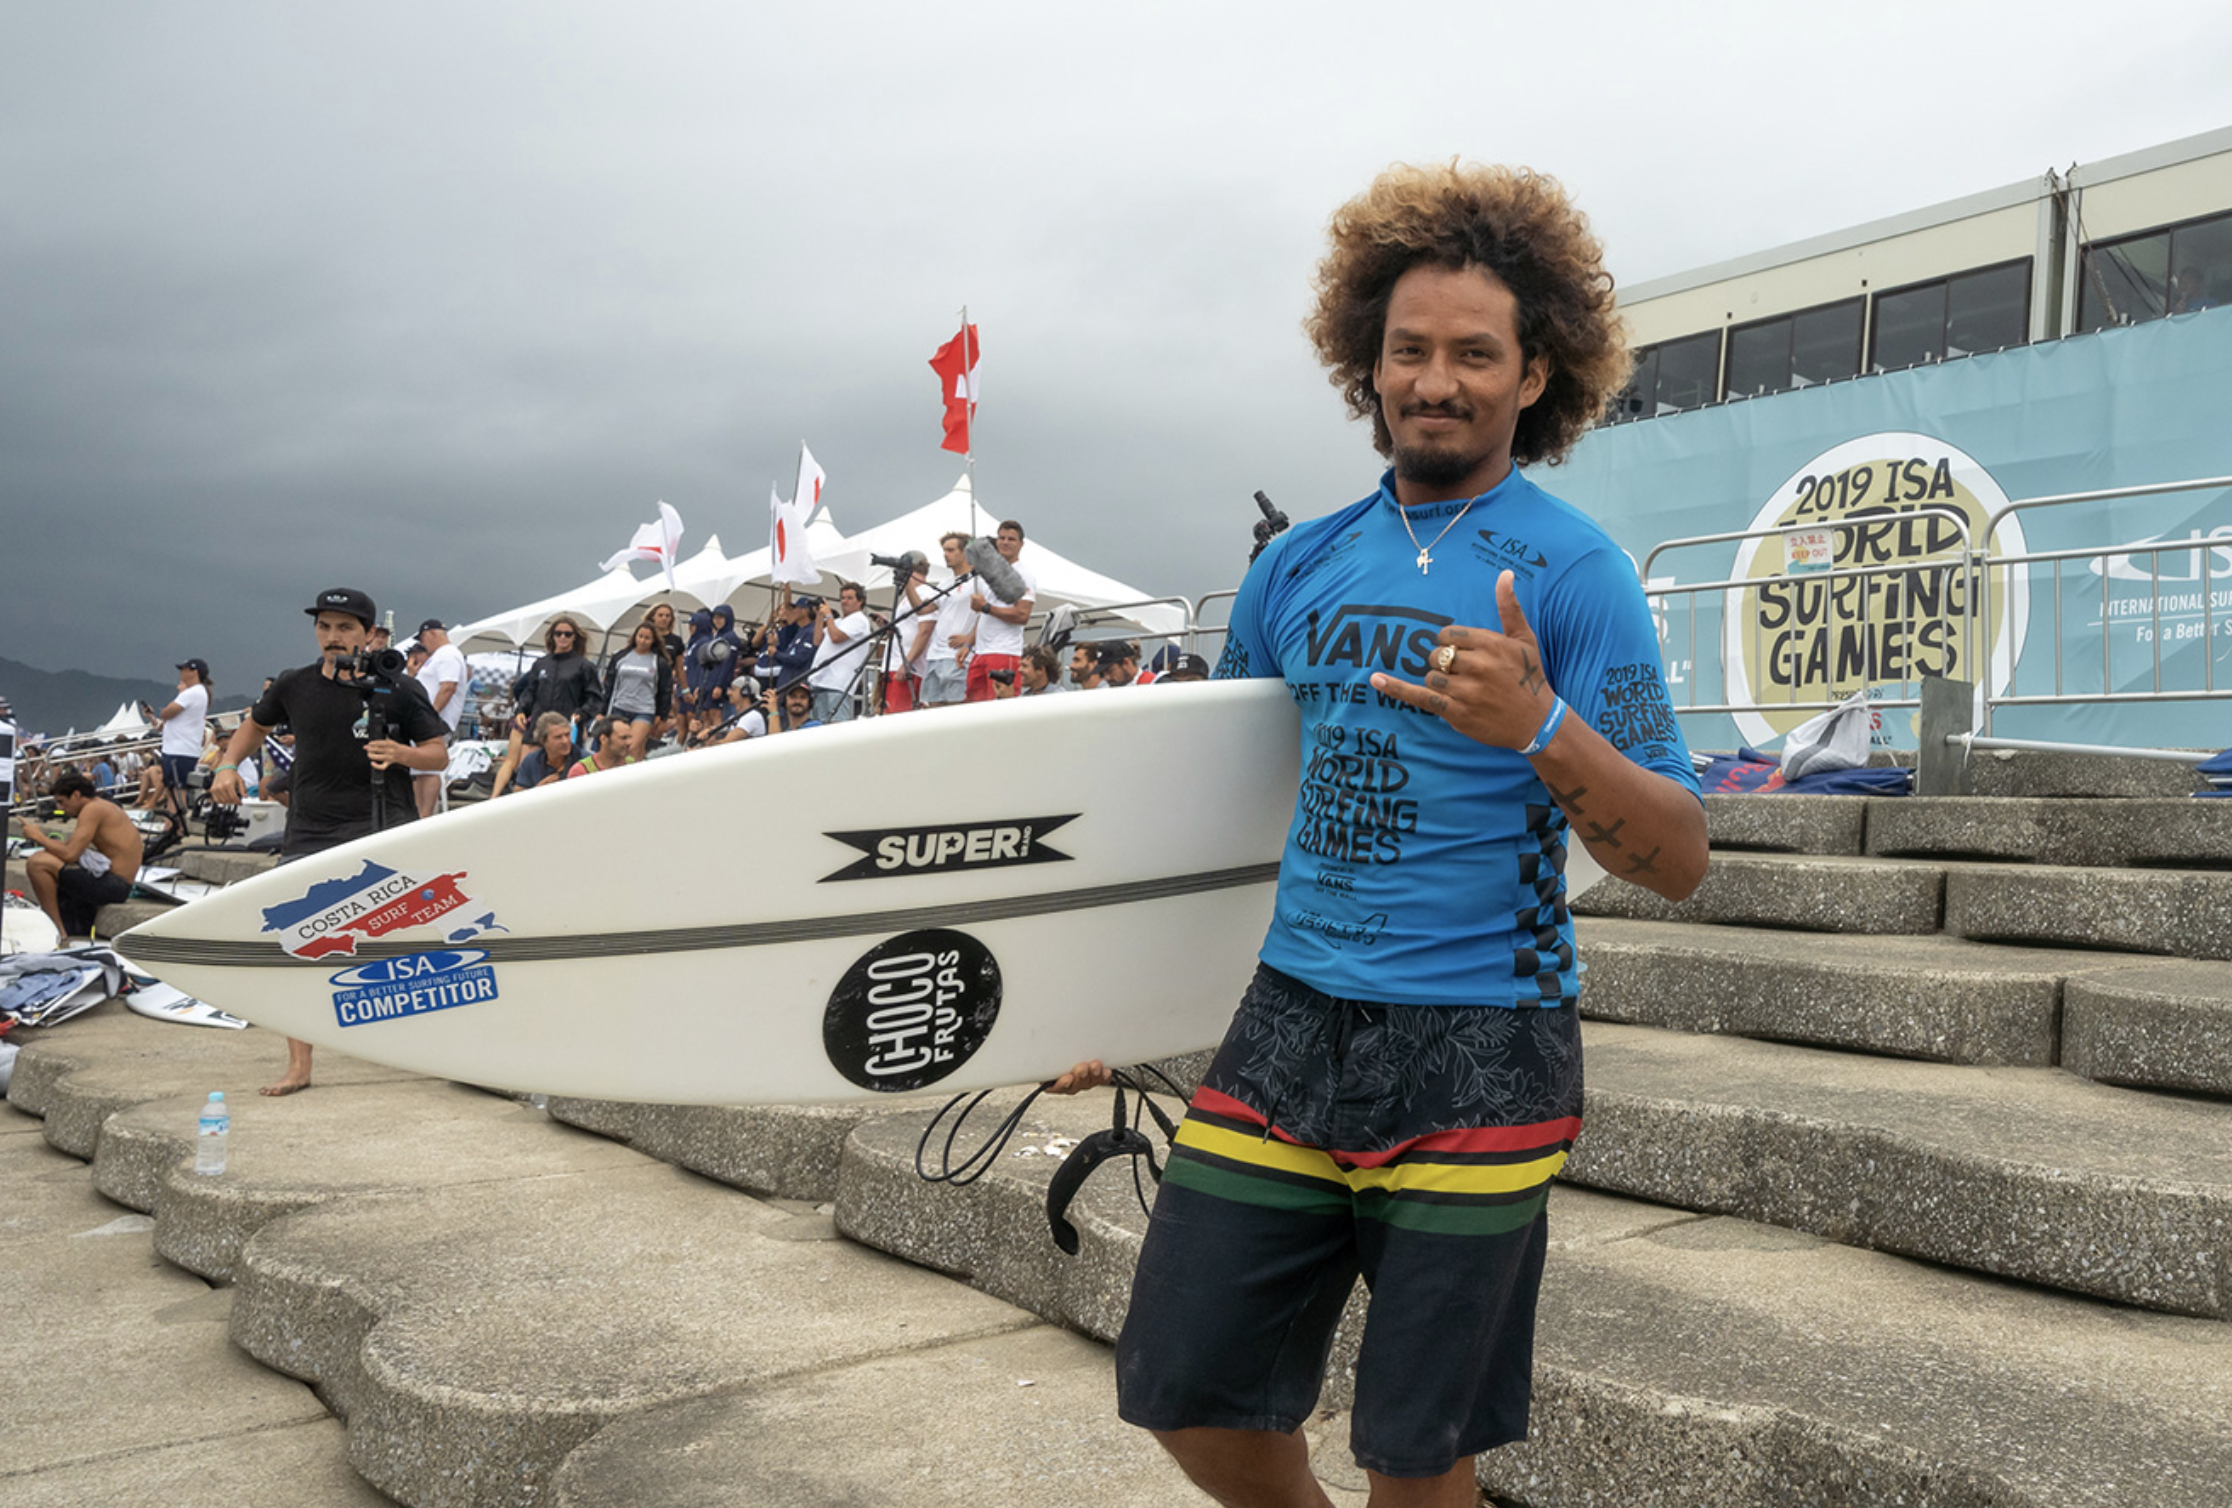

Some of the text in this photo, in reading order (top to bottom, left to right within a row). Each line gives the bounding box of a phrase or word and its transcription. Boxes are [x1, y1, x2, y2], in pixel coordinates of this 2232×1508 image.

[1796, 458, 1955, 515] 2019 ISA
[1500, 538, 1528, 559] ISA
[1779, 503, 1970, 564] ORLD
[1307, 605, 1455, 677] VANS
[2163, 628, 2172, 640] a
[2176, 622, 2220, 639] Bettr
[1770, 619, 1957, 688] GAMES
[1606, 664, 1638, 685] 2019
[1639, 663, 1658, 681] ISA
[1325, 683, 1367, 704] THE
[1601, 681, 1664, 708] WORLD
[1354, 727, 1399, 760] ISA
[1611, 722, 1677, 751] GAMES
[1307, 746, 1410, 793] WORLD
[875, 827, 1021, 870] SUPER
[1297, 816, 1401, 865] GAMES
[298, 875, 418, 939] COSTA RICA
[368, 902, 409, 930] SURF
[411, 895, 459, 923] TEAM
[336, 968, 489, 1002] FOR A BETTER SURFING FUTURE
[386, 955, 436, 981] ISA
[340, 978, 494, 1023] COMPETITOR
[864, 952, 936, 1076] CHOCO
[934, 949, 965, 1063] FRUTAS
